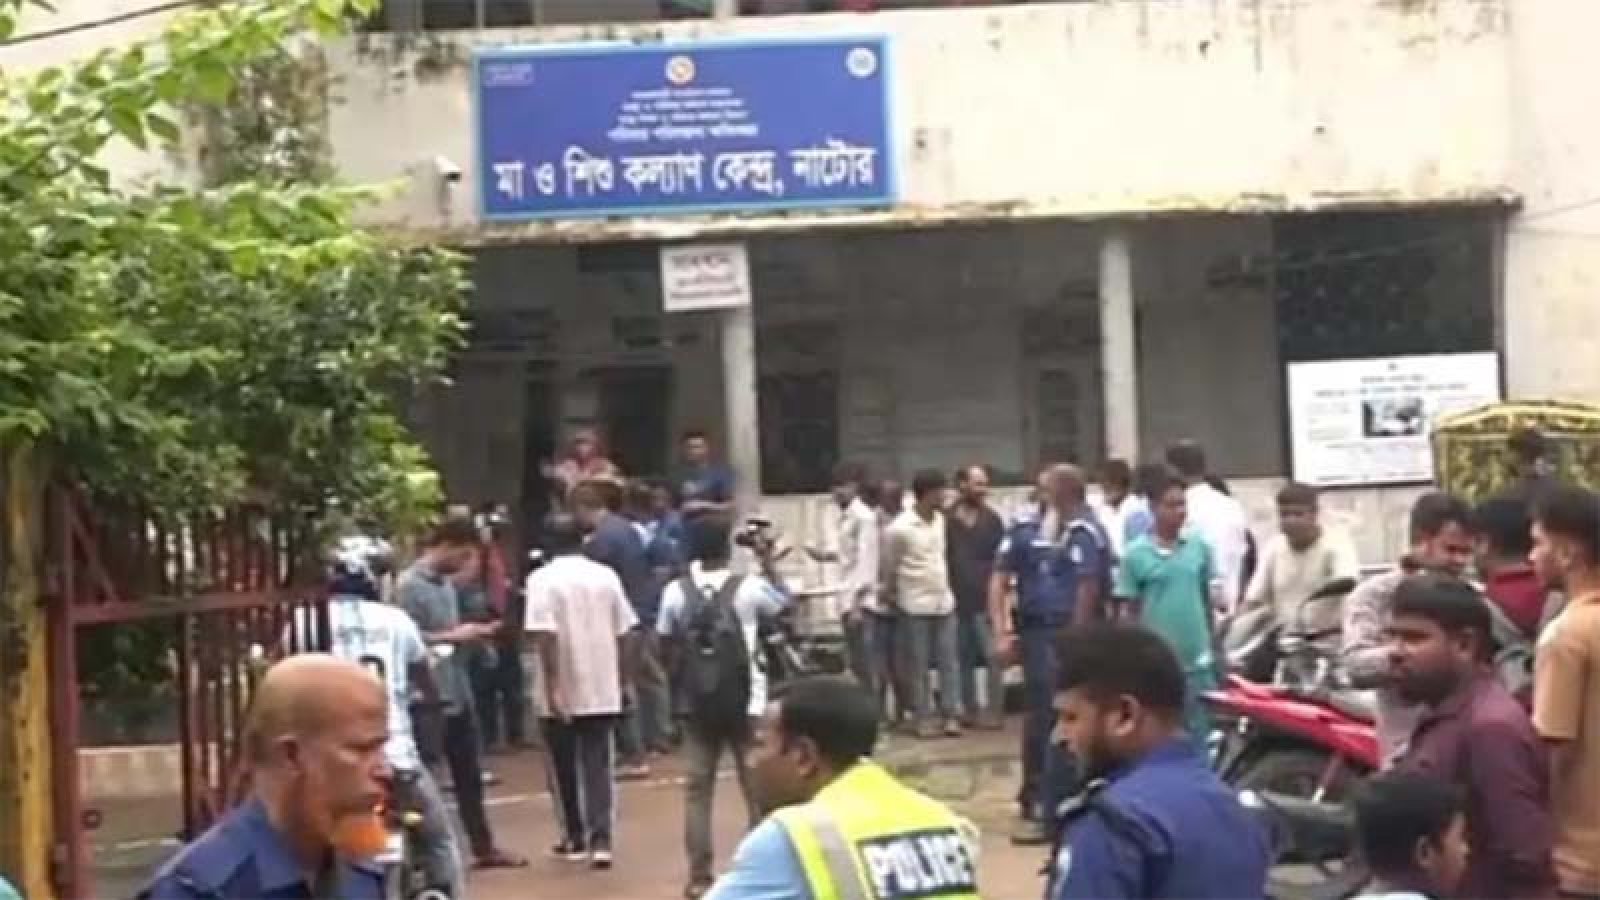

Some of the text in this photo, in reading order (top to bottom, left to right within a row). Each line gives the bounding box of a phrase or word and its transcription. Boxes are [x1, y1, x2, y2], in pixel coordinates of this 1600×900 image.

[493, 161, 524, 198] মা
[533, 162, 555, 195] ও
[563, 145, 614, 197] শিশু
[620, 153, 704, 194] কল্যাণ
[789, 138, 877, 185] নাটোর
[864, 834, 973, 897] POLICE
